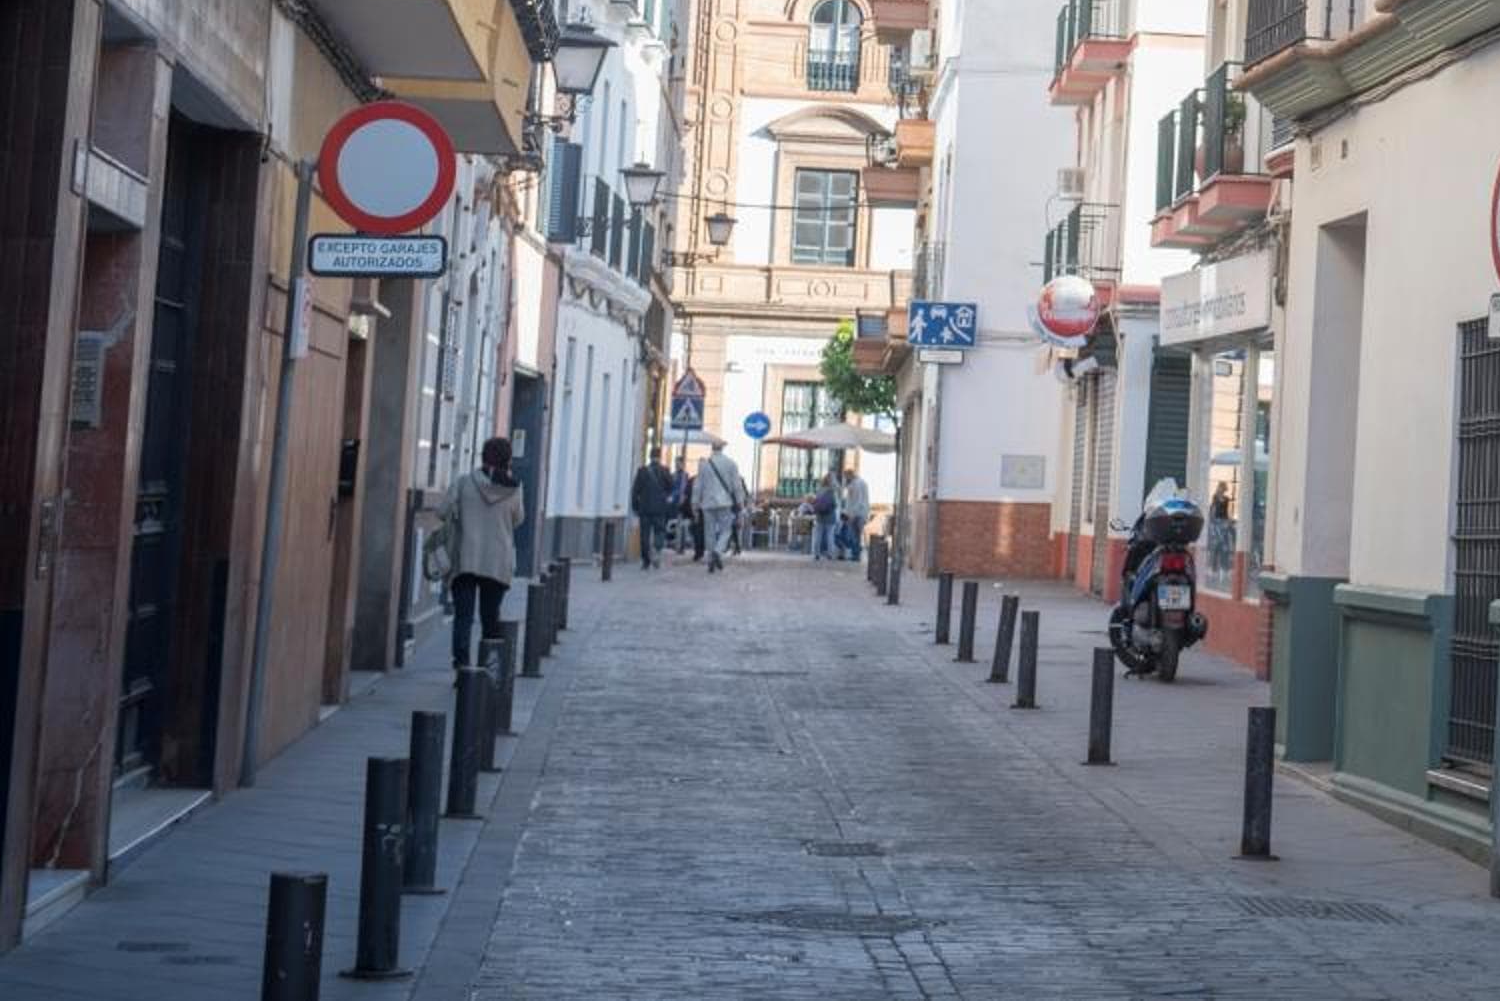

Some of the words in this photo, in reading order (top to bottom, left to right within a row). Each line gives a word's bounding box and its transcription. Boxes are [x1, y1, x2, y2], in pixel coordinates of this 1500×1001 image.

[318, 242, 378, 253] EXCEPTO
[381, 241, 439, 253] GARAJES
[333, 256, 423, 268] AUTORIZADOS
